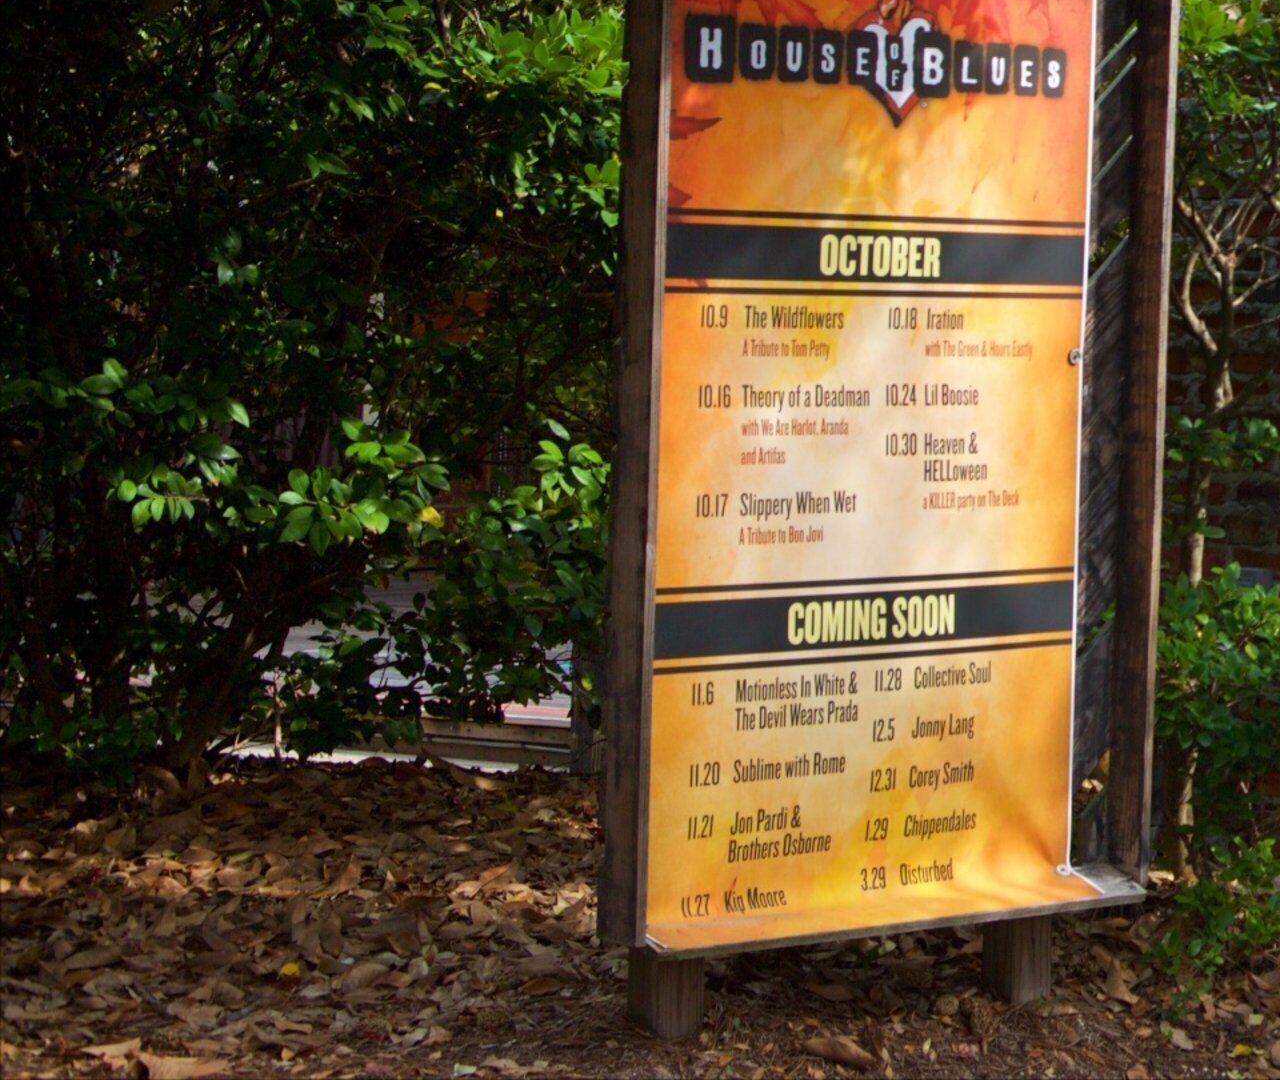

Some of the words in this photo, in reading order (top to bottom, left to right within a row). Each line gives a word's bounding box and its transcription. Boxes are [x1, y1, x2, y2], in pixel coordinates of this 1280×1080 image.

[700, 27, 870, 76] HOUSE
[923, 48, 1060, 89] BLUES
[820, 234, 941, 278] OCTOBER
[701, 304, 728, 328] 10.9
[745, 305, 767, 328] The
[771, 305, 844, 329] Wildflowers
[888, 307, 917, 330] 10.18
[926, 308, 964, 330] Iration
[698, 385, 731, 408] 10.16
[742, 385, 784, 413] Theory
[788, 385, 801, 408] of
[804, 390, 811, 408] a
[815, 385, 870, 408] Deadman
[885, 384, 916, 406] 10.24
[924, 385, 938, 406] Lil
[942, 384, 979, 406] Boosie
[885, 433, 917, 456] 10.30
[924, 433, 965, 455] Heaven
[969, 432, 978, 454] &
[923, 459, 988, 482] HELLoween
[696, 494, 728, 518] 10.17
[739, 492, 792, 521] Slippery
[796, 491, 830, 514] When
[833, 490, 856, 513] Wet
[788, 598, 887, 645] COMING
[892, 594, 956, 638] SOON
[692, 682, 714, 706] 11.6
[736, 677, 798, 703] Motionless
[801, 675, 811, 697] In
[814, 674, 845, 696] White
[848, 671, 858, 694] &
[874, 668, 902, 692] 11.28
[914, 665, 966, 689] Collective
[969, 661, 992, 684] Soul
[736, 707, 755, 731] The
[759, 705, 787, 729] Devil
[790, 703, 824, 726] Wears
[827, 700, 858, 723] Prada
[873, 718, 895, 742] 12.5
[912, 716, 946, 741] Jonny
[949, 713, 974, 739] Lang
[690, 762, 720, 788] 11.20
[733, 758, 781, 784] Sublime
[785, 753, 810, 778] with
[813, 752, 846, 776] Rome
[870, 768, 896, 793] 12.31
[909, 766, 940, 791] Corey
[943, 760, 974, 784] Smith
[688, 815, 714, 840] 11.21
[730, 812, 753, 835] Jon
[757, 807, 788, 832] Pardi
[791, 804, 801, 828] &
[865, 818, 888, 842] 1.29
[904, 809, 977, 840] Chippendales
[728, 839, 779, 863] Brothers
[782, 833, 831, 857] Osborne
[861, 867, 886, 891] 3.29
[900, 858, 953, 886] Disturbed
[681, 894, 710, 919] 11.27
[724, 891, 745, 914] Kip
[748, 888, 787, 909] Moore
